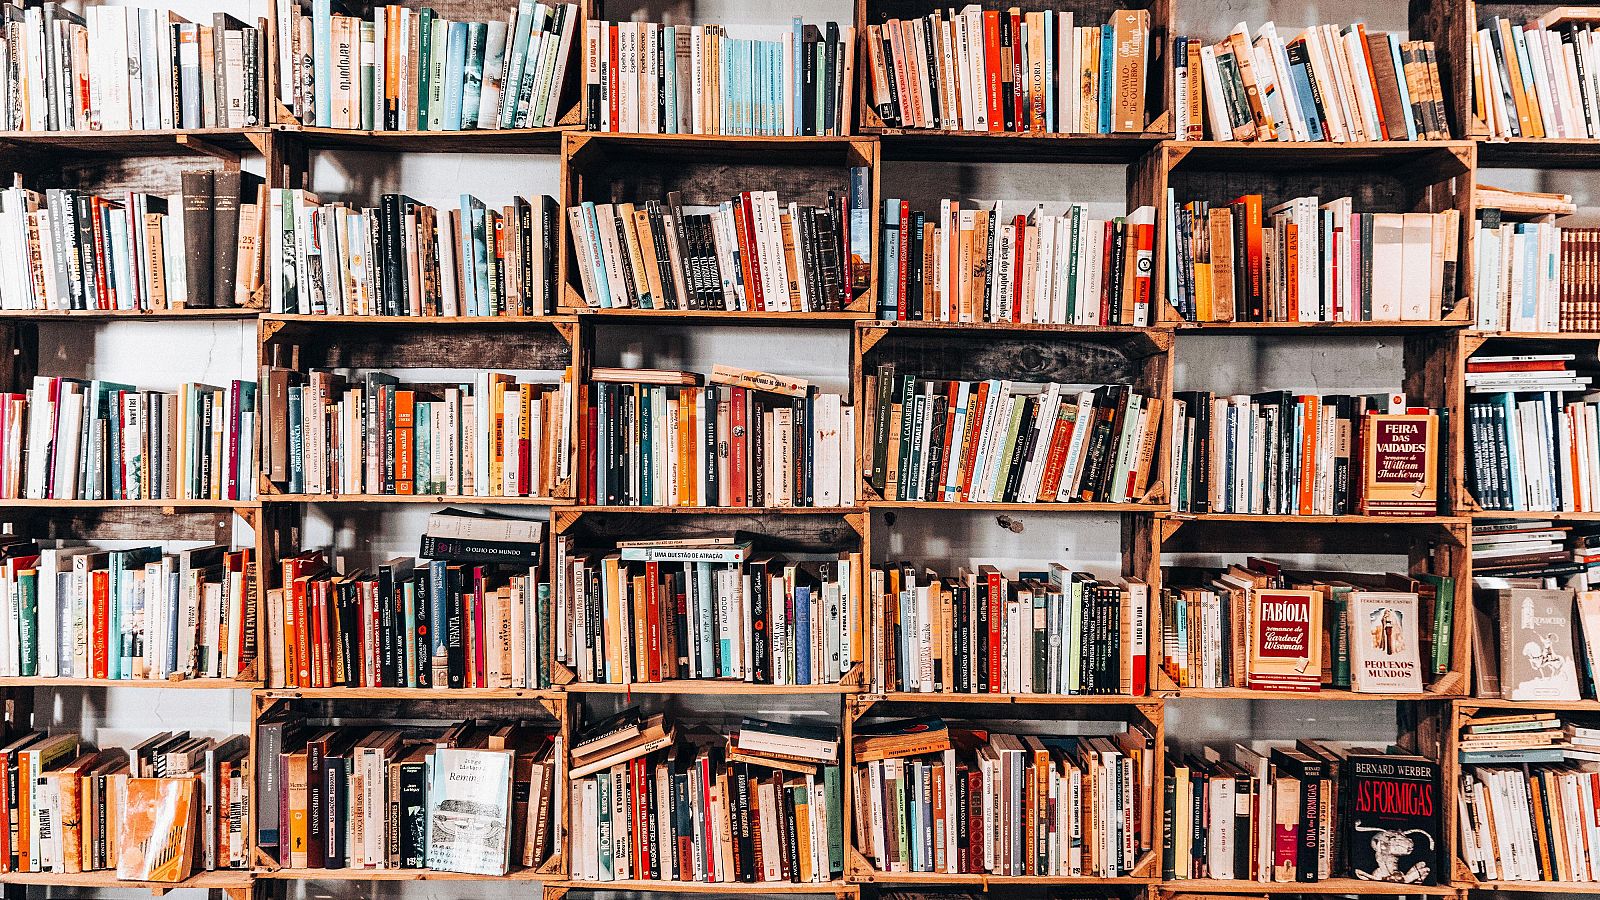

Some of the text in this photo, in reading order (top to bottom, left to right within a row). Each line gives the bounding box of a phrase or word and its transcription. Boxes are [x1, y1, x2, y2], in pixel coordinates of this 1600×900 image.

[337, 43, 350, 91] aeroporto
[1014, 64, 1022, 97] d'Artagnan
[55, 243, 61, 251] DO
[1000, 273, 1008, 294] pobres
[1000, 295, 1008, 318] amantes
[128, 398, 137, 426] howard fast
[1385, 424, 1418, 434] FEIRA
[1376, 443, 1425, 453] VAIDADES
[1383, 461, 1418, 469] William
[1377, 470, 1424, 480] Thackeray
[498, 548, 521, 556] MUNDO
[245, 580, 256, 647] TEIA ENVOLVENTE
[1262, 601, 1308, 623] FABÍOLA
[449, 616, 460, 647] INFANTA
[498, 632, 503, 640] OS
[1265, 632, 1302, 643] Cardeal
[1338, 611, 1347, 654] EMBAIXADOR
[96, 639, 104, 655] Noite
[1264, 642, 1304, 651] Wiseman
[1364, 661, 1414, 670] PEQUENOS
[1368, 670, 1411, 678] MUNDOS
[1355, 763, 1432, 777] BERNARD WERBER
[615, 773, 623, 806] romana
[1308, 784, 1317, 818] FORMIGAS
[1356, 781, 1433, 817] AS FORMIGAS
[39, 808, 51, 840] PERAHIM
[230, 802, 241, 833] PERAHIM
[1029, 829, 1033, 837] DO
[1164, 809, 1172, 849] LAMIA
[1308, 829, 1316, 840] DIA
